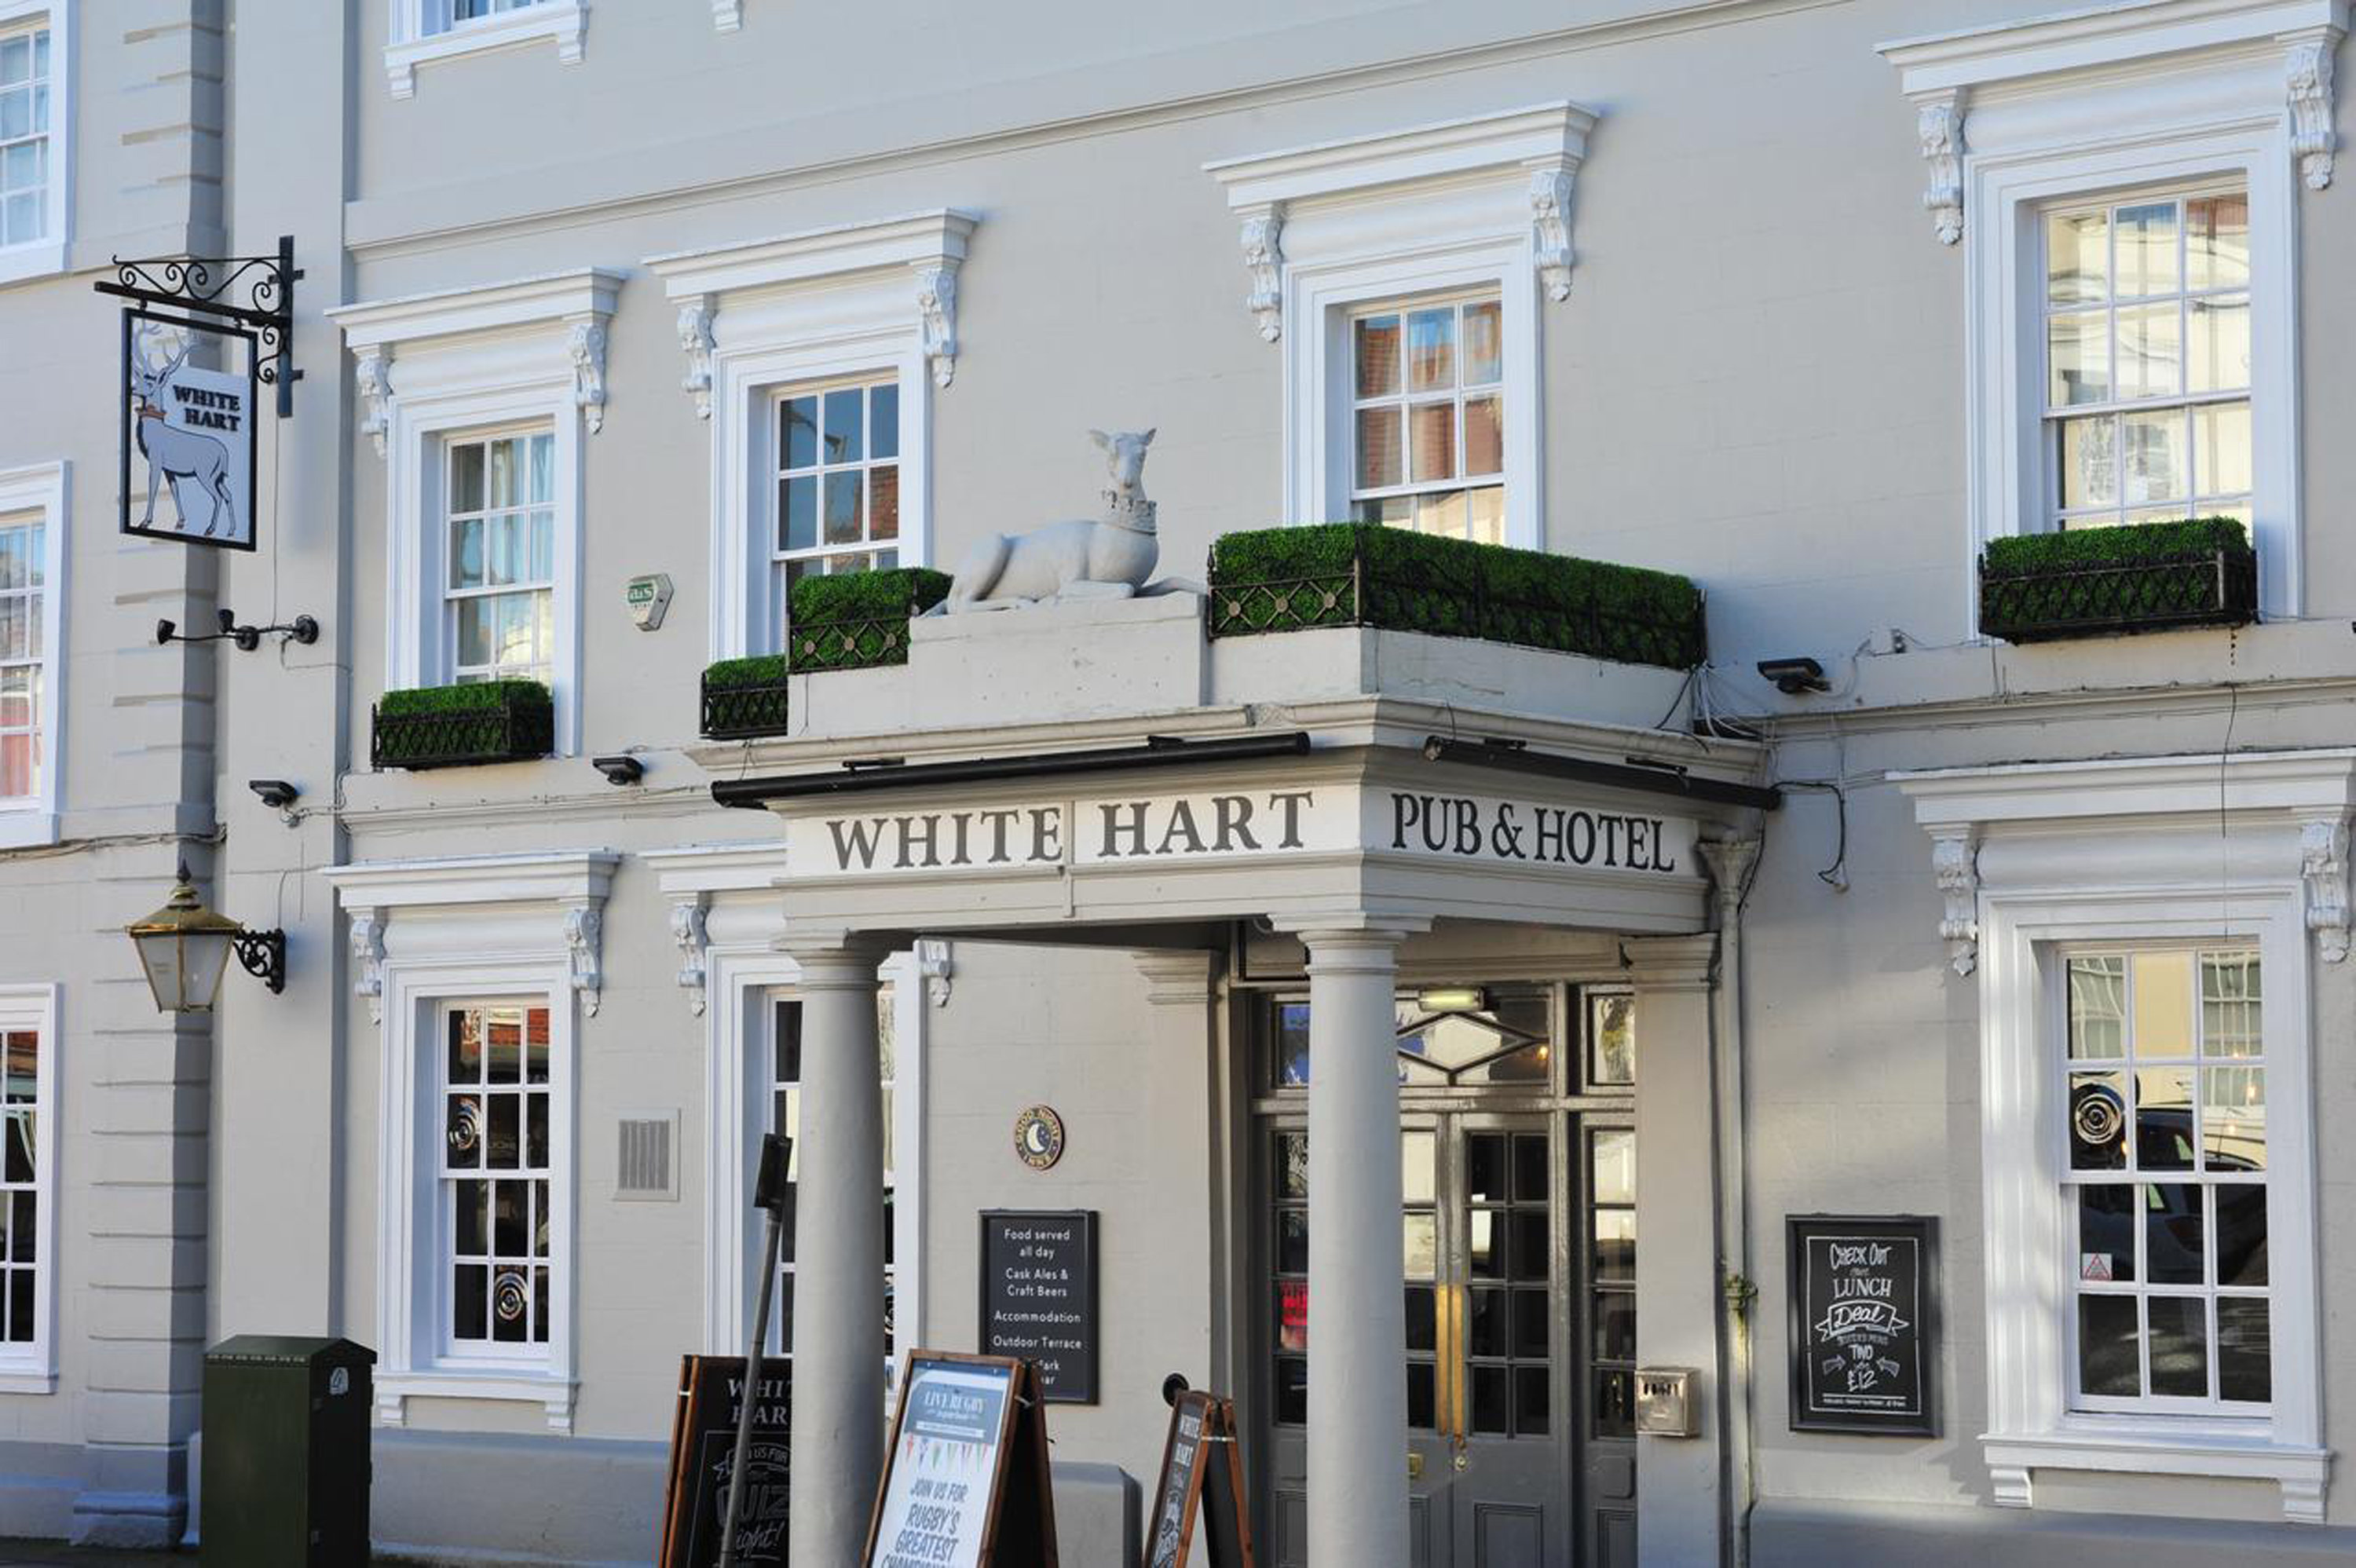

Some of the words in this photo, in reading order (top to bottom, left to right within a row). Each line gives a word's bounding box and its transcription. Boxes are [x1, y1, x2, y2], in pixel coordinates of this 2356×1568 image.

[173, 384, 240, 411] WHITE
[185, 407, 241, 432] HART
[826, 806, 1063, 870] WHITE
[1097, 791, 1314, 857] HART
[1391, 792, 1482, 855] PUB
[1492, 802, 1526, 860] &
[1534, 807, 1675, 872] HOTEL
[1004, 1229, 1032, 1240] Food
[1035, 1229, 1070, 1241] served
[1019, 1245, 1033, 1257] all
[1035, 1246, 1055, 1261] day
[1830, 1242, 1868, 1270] CHECK
[1005, 1267, 1030, 1280] Cask
[1033, 1268, 1057, 1280] Ales
[1060, 1268, 1068, 1280] &
[1007, 1284, 1033, 1296] Craft
[1037, 1285, 1067, 1296] Beers
[1833, 1278, 1892, 1299] LUNCH
[993, 1310, 1081, 1323] Accommodation
[1834, 1305, 1886, 1328] Deal
[993, 1335, 1038, 1347] Outdoor
[1041, 1336, 1083, 1349] Terrace
[1848, 1344, 1873, 1360] TWO
[727, 1378, 791, 1398] WHI
[1847, 1369, 1878, 1392] £12
[732, 1405, 788, 1426] HAR
[905, 1503, 960, 1534] RUGBY'S
[894, 1530, 959, 1562] GREATEST
